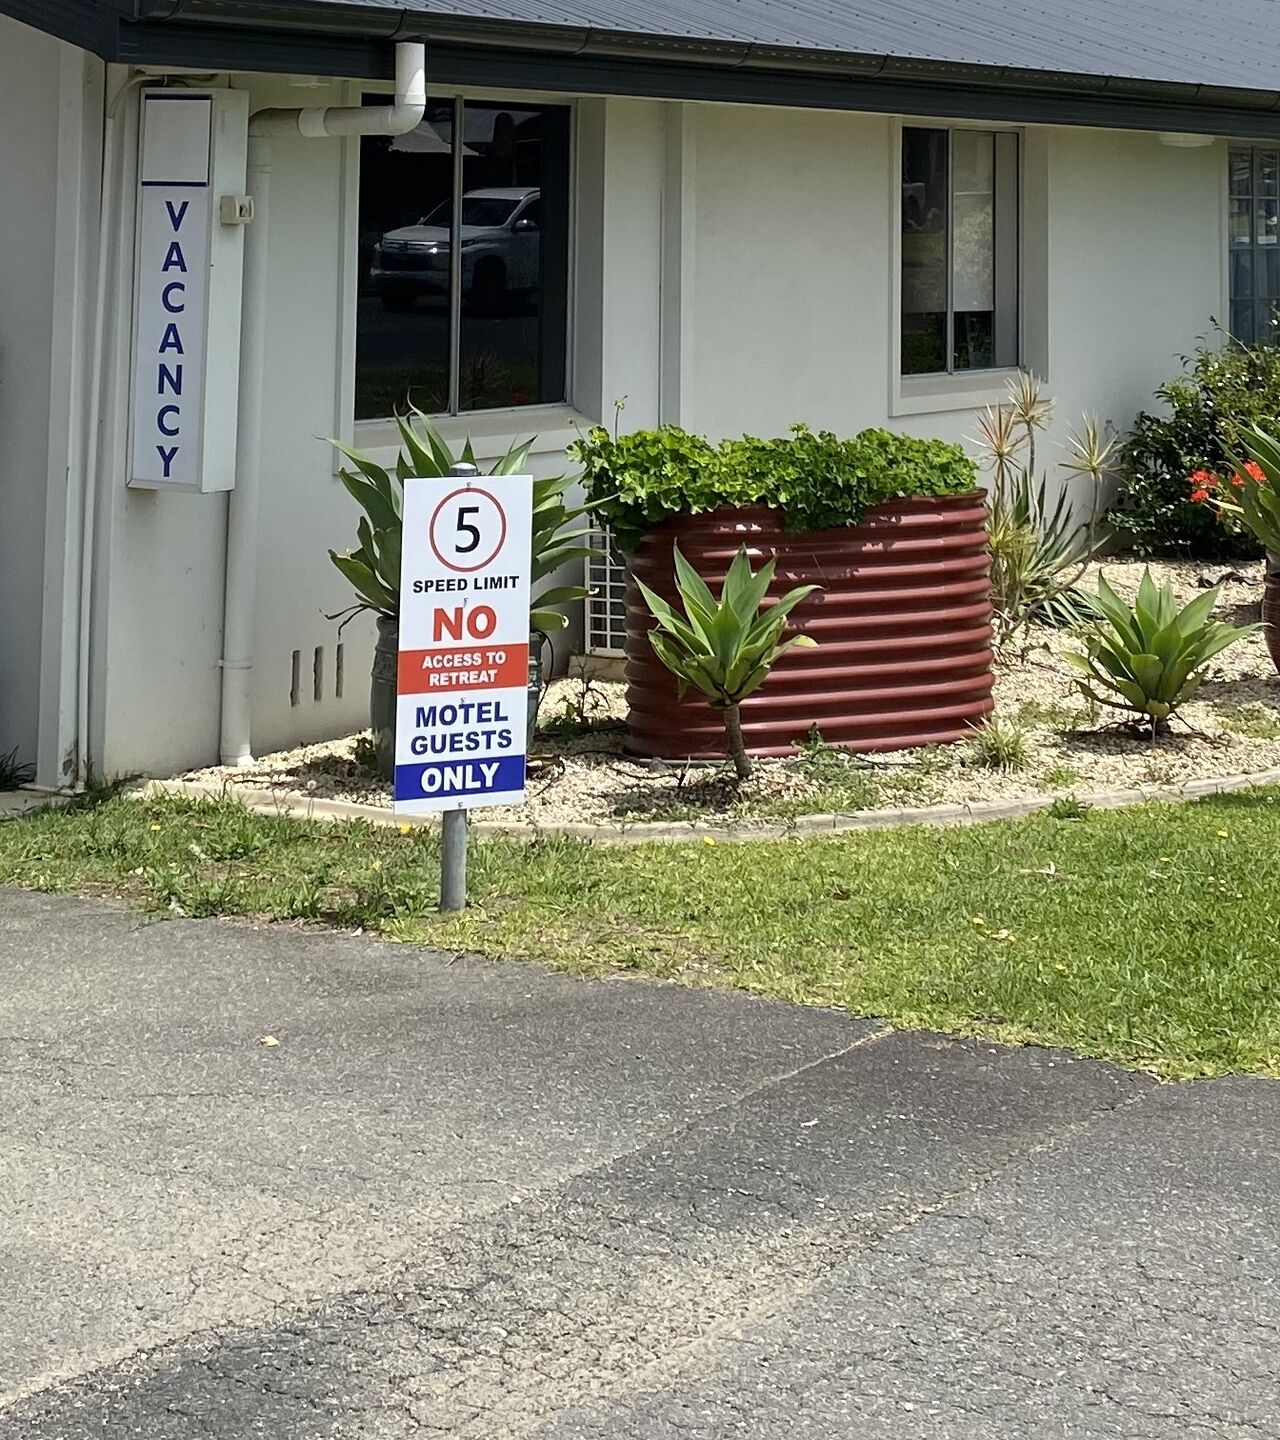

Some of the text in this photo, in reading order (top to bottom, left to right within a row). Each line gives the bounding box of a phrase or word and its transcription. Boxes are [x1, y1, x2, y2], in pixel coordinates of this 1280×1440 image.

[157, 200, 189, 479] VACANCY
[454, 506, 481, 553] 5
[413, 575, 519, 594] SPEED LIMIT
[433, 605, 497, 642] NO
[421, 651, 506, 669] ACCESS TO
[429, 669, 497, 686] RETREAT
[415, 701, 508, 728] MOTEL
[411, 728, 512, 756] GUESTS
[420, 762, 500, 793] ONLY
